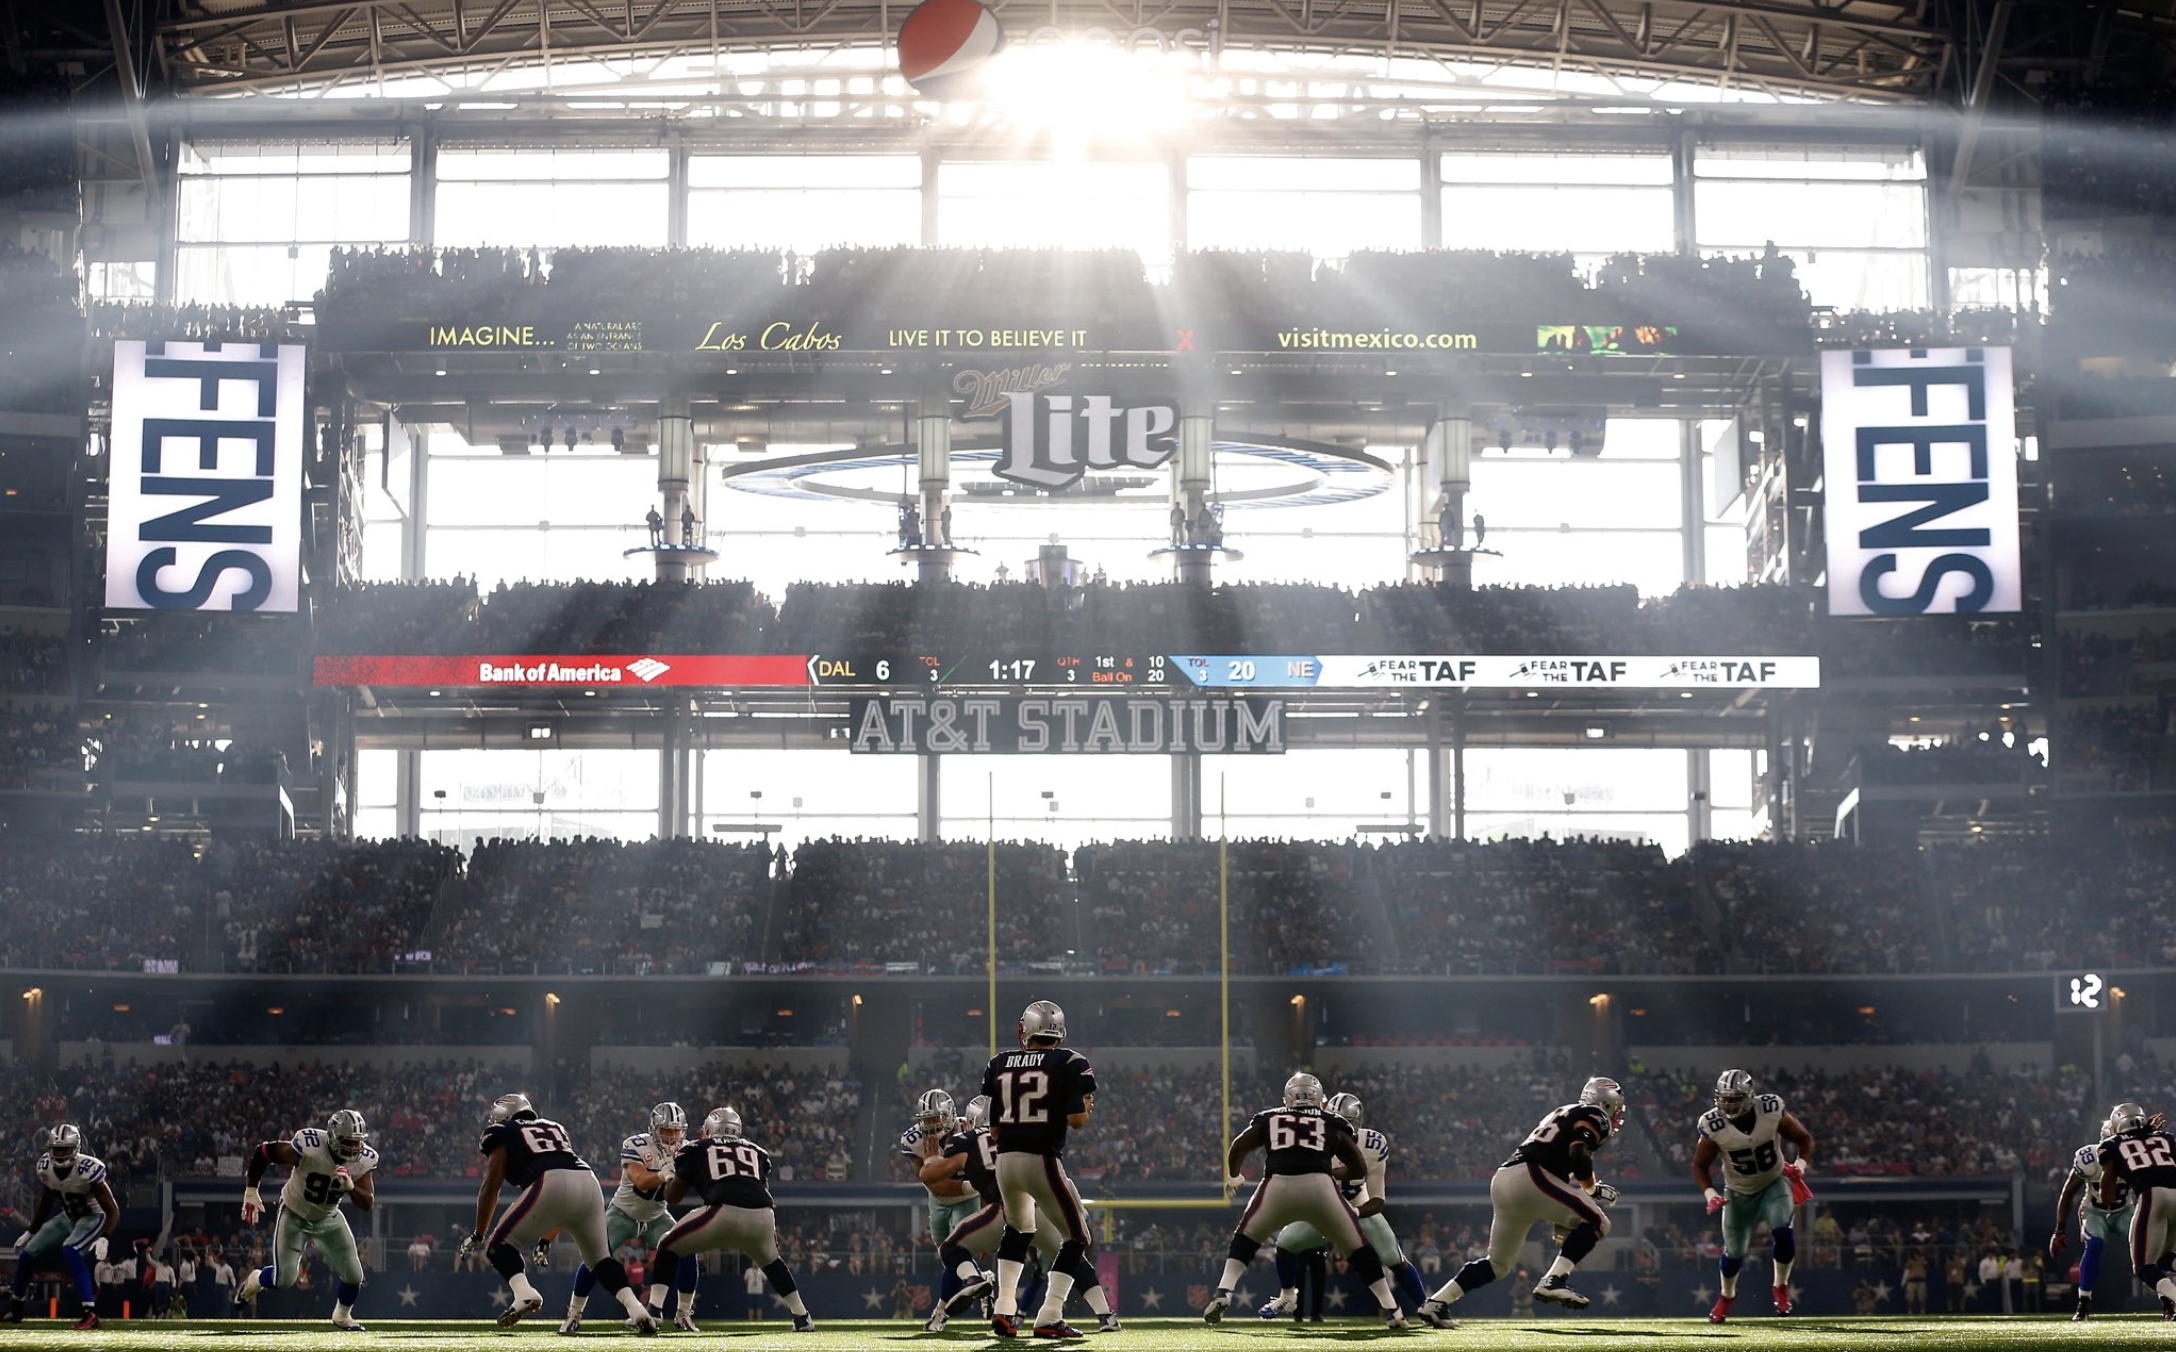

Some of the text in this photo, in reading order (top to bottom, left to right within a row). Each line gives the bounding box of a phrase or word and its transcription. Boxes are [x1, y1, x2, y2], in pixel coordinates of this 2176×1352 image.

[429, 326, 555, 346] IMAGINE...
[694, 321, 842, 351] Los Cabos
[888, 329, 1087, 347] LIVE IT TO BELIEVE IT
[1277, 326, 1478, 349] visitmexico.com
[953, 362, 1072, 410] Miller
[1000, 391, 1175, 487] Lite
[136, 340, 279, 612] FENS
[1851, 348, 1994, 615] FENS
[479, 662, 622, 682] Bank of America
[818, 659, 890, 681] DAL 6
[918, 656, 940, 667] TOL
[988, 659, 1036, 680] 1:17
[1095, 655, 1115, 669] 1st
[1149, 655, 1165, 669] 10
[1187, 657, 1210, 668] TOL
[1227, 660, 1315, 682] 20 NE
[1379, 660, 1417, 671] FEAR
[1418, 661, 1476, 682] TAF
[1530, 660, 1568, 671] FEAR
[1570, 661, 1627, 682] TAF
[1681, 660, 1718, 671] FEAR
[1720, 661, 1776, 682] TAF
[930, 669, 939, 682] 3
[1067, 669, 1076, 682] 3
[1092, 669, 1165, 683] Ball On 20
[1199, 669, 1208, 683] 3
[1391, 672, 1417, 683] THE
[1542, 672, 1568, 683] THE
[1693, 672, 1718, 683] THE
[852, 699, 1284, 752] AT&T STADIUM
[1005, 1053, 1046, 1068] BRADY
[996, 1070, 1049, 1124] 12
[520, 1125, 575, 1154] 61
[1269, 1114, 1326, 1151] 63
[706, 1144, 761, 1181] 69
[1728, 1139, 1778, 1176] 58
[2079, 1146, 2095, 1166] 39
[2118, 1136, 2176, 1171] 82
[78, 1160, 96, 1176] 42
[303, 1171, 346, 1205] 92
